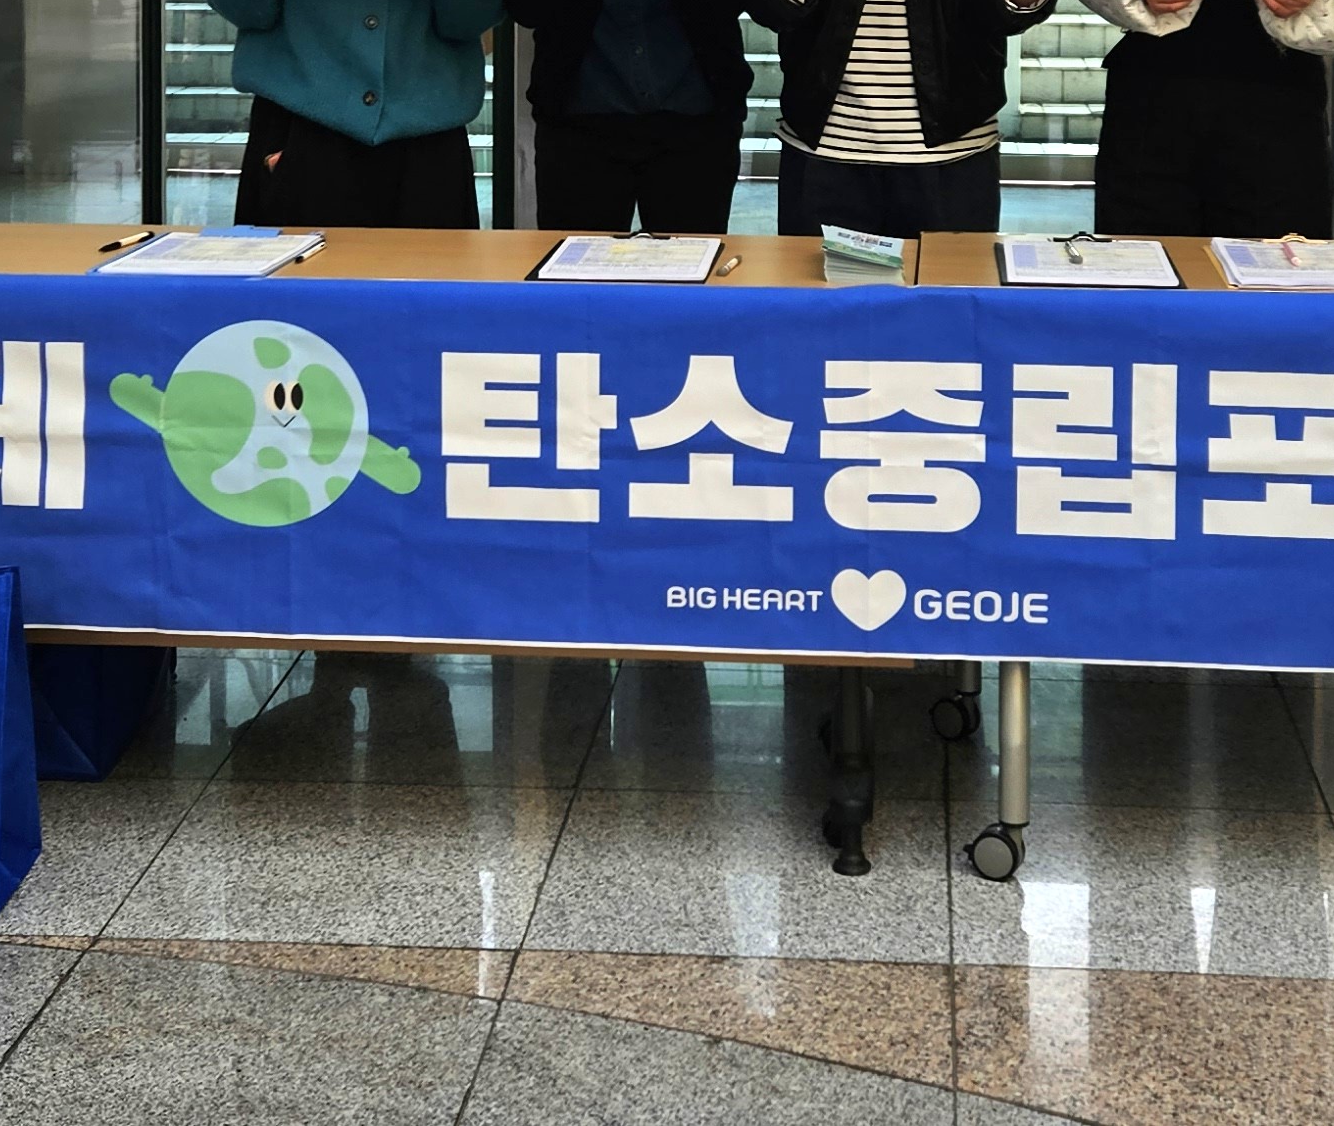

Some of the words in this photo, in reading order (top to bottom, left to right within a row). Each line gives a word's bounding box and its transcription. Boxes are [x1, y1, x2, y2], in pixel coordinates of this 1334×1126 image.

[667, 585, 717, 610] BIG
[723, 587, 824, 613] HEART
[913, 588, 1050, 625] GEOJE
